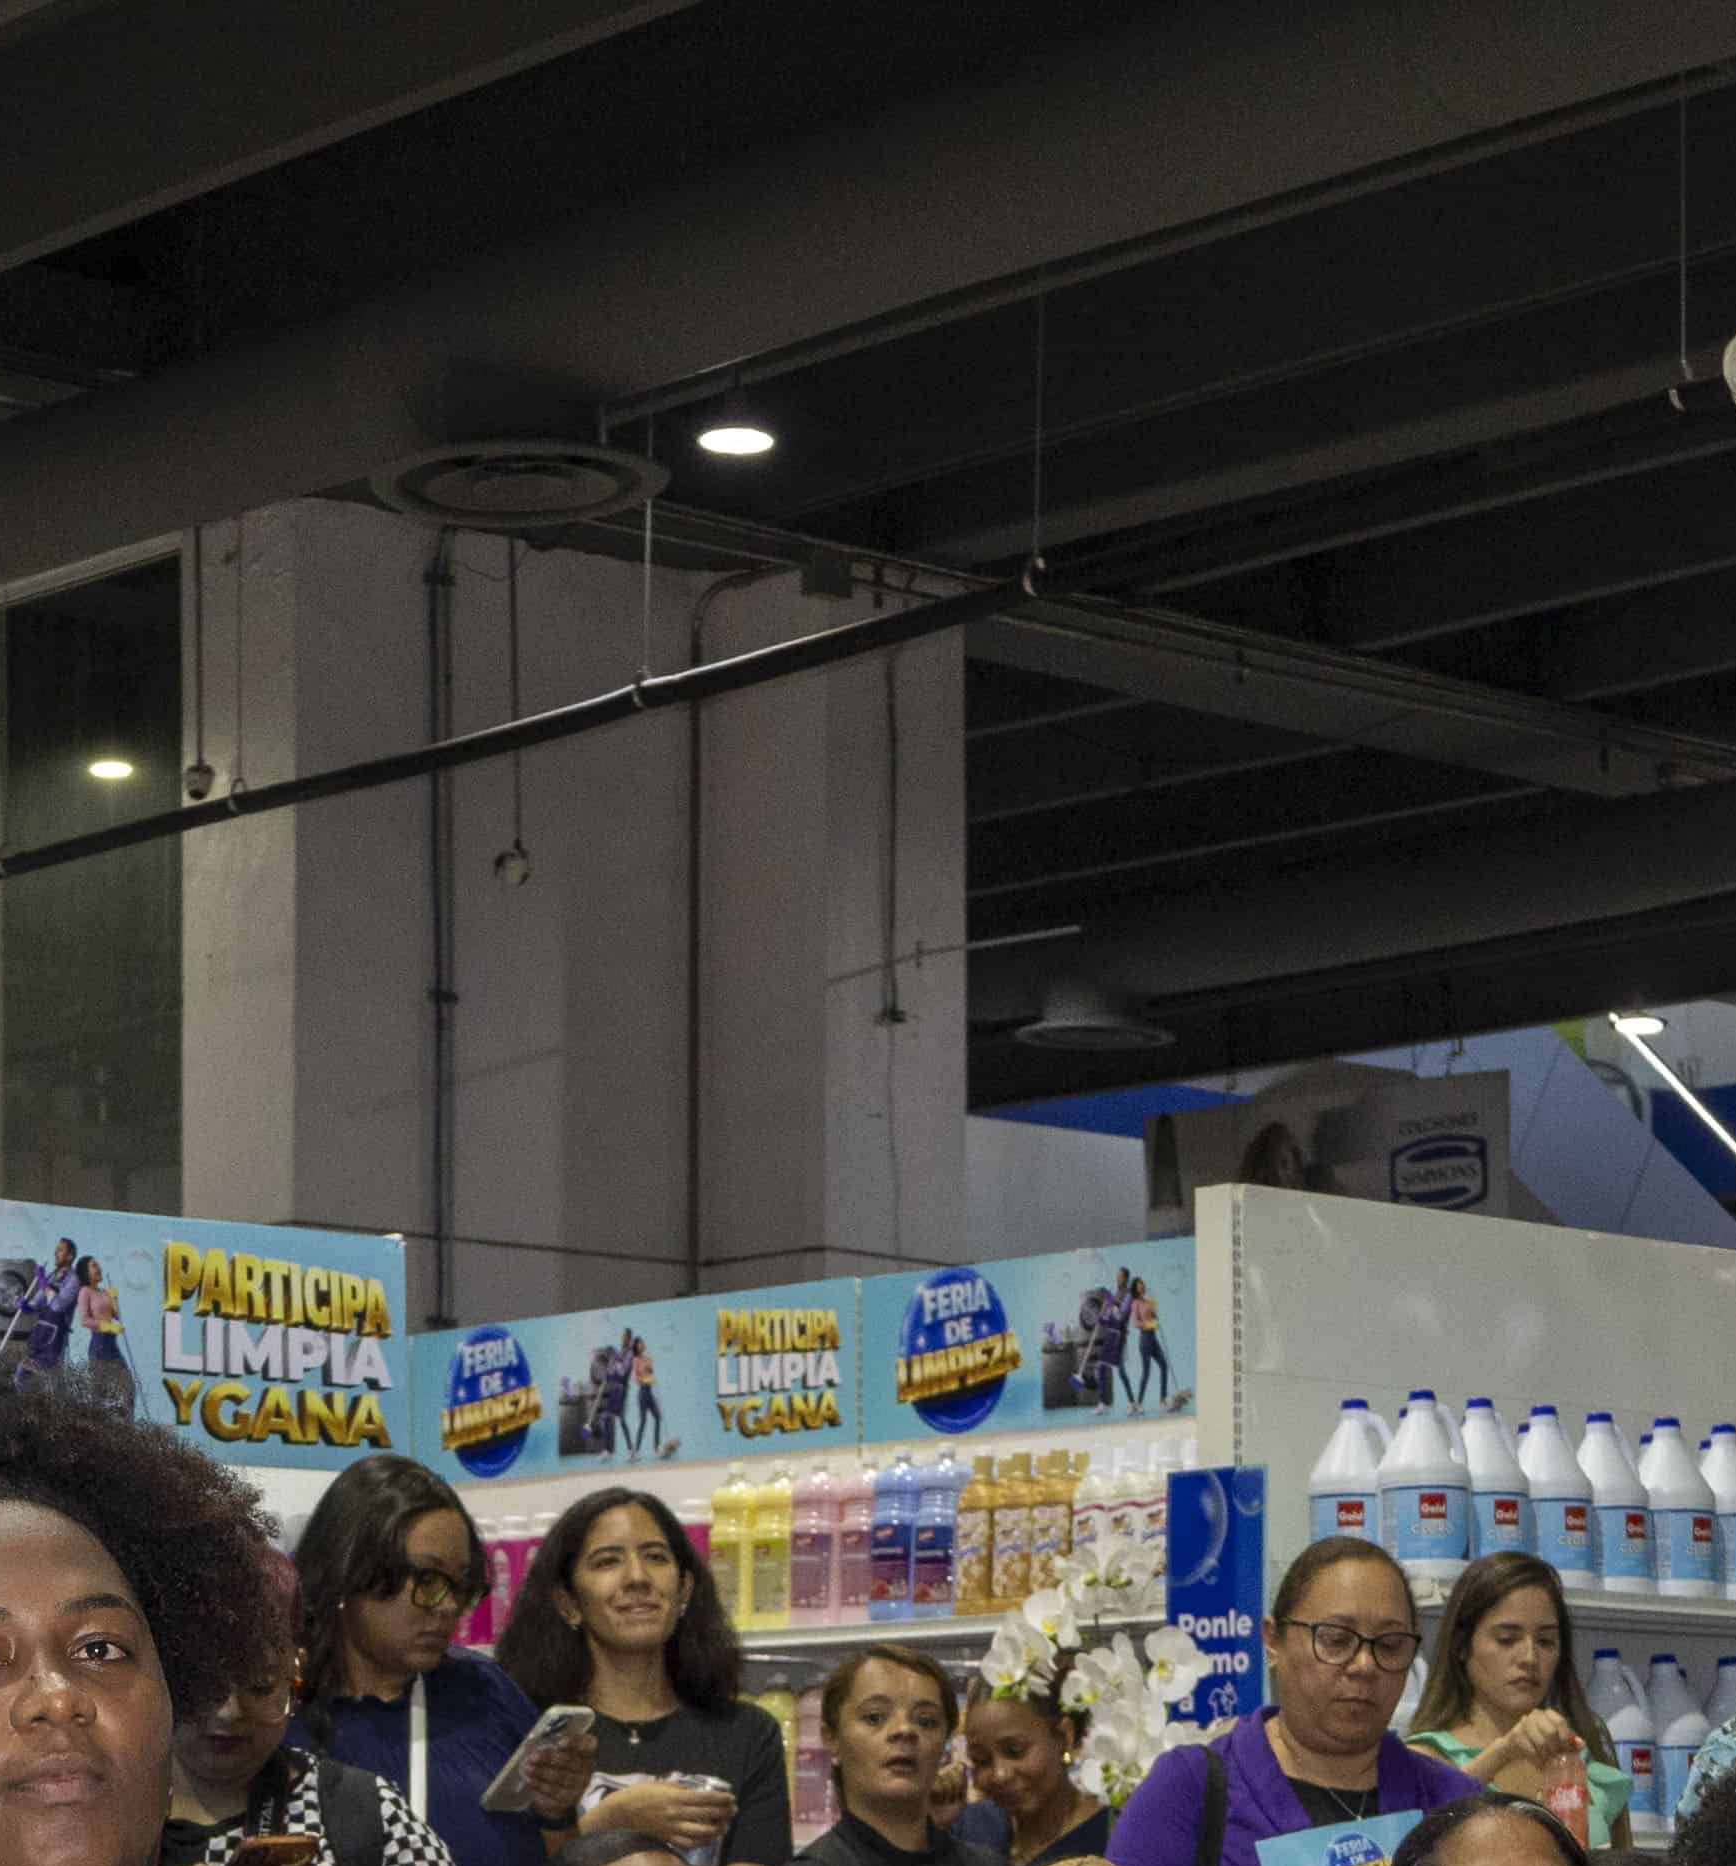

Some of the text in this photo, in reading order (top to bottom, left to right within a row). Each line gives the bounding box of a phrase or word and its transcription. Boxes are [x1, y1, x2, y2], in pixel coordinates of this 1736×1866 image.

[165, 1241, 391, 1337] PARTICIPA
[916, 1277, 992, 1325] FERIA
[165, 1312, 391, 1390] LIMPIA
[717, 1309, 841, 1357] PARTICIPA
[944, 1316, 973, 1346] DE
[458, 1336, 519, 1379] FERIA
[717, 1350, 842, 1397] LIMPIA
[479, 1371, 504, 1396] DE
[1179, 1608, 1253, 1640] Ponle
